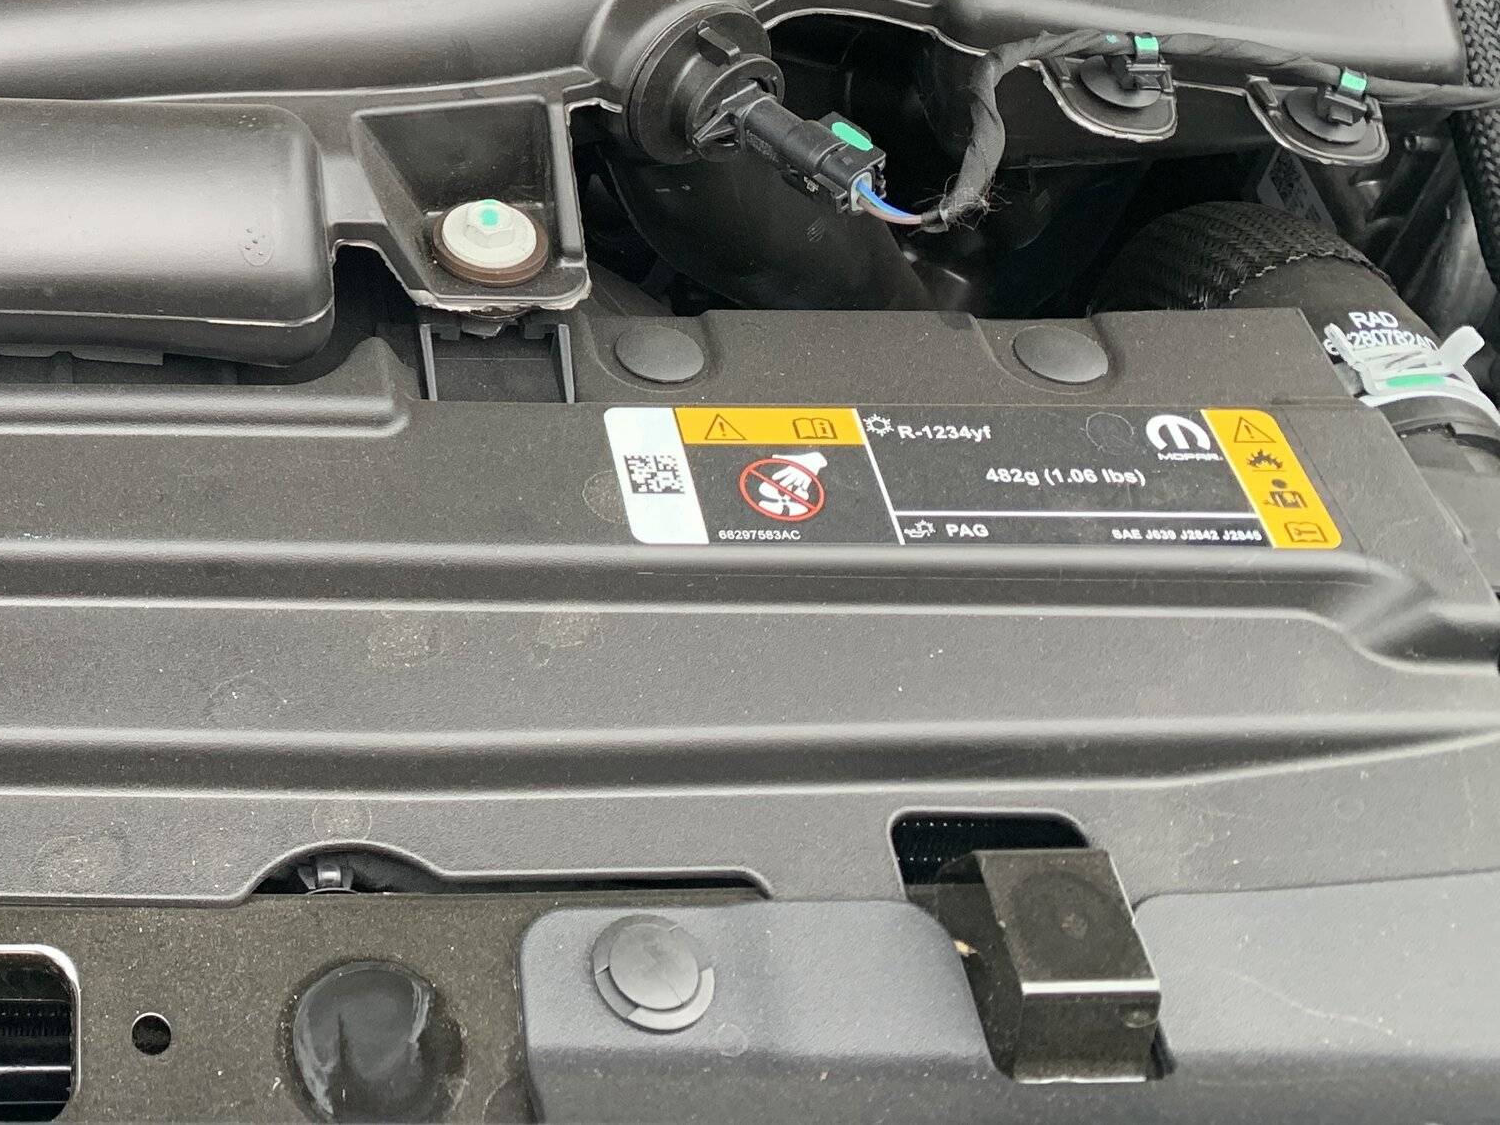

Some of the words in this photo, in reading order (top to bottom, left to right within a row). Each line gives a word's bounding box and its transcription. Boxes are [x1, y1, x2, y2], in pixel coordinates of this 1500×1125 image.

[1348, 311, 1399, 329] RAD
[897, 425, 992, 442] R-1234yf
[986, 468, 1041, 486] 482g
[1044, 468, 1098, 486] (1.06
[1102, 468, 1146, 487] lbs)
[945, 524, 990, 538] PAG
[1112, 529, 1143, 540] SAE
